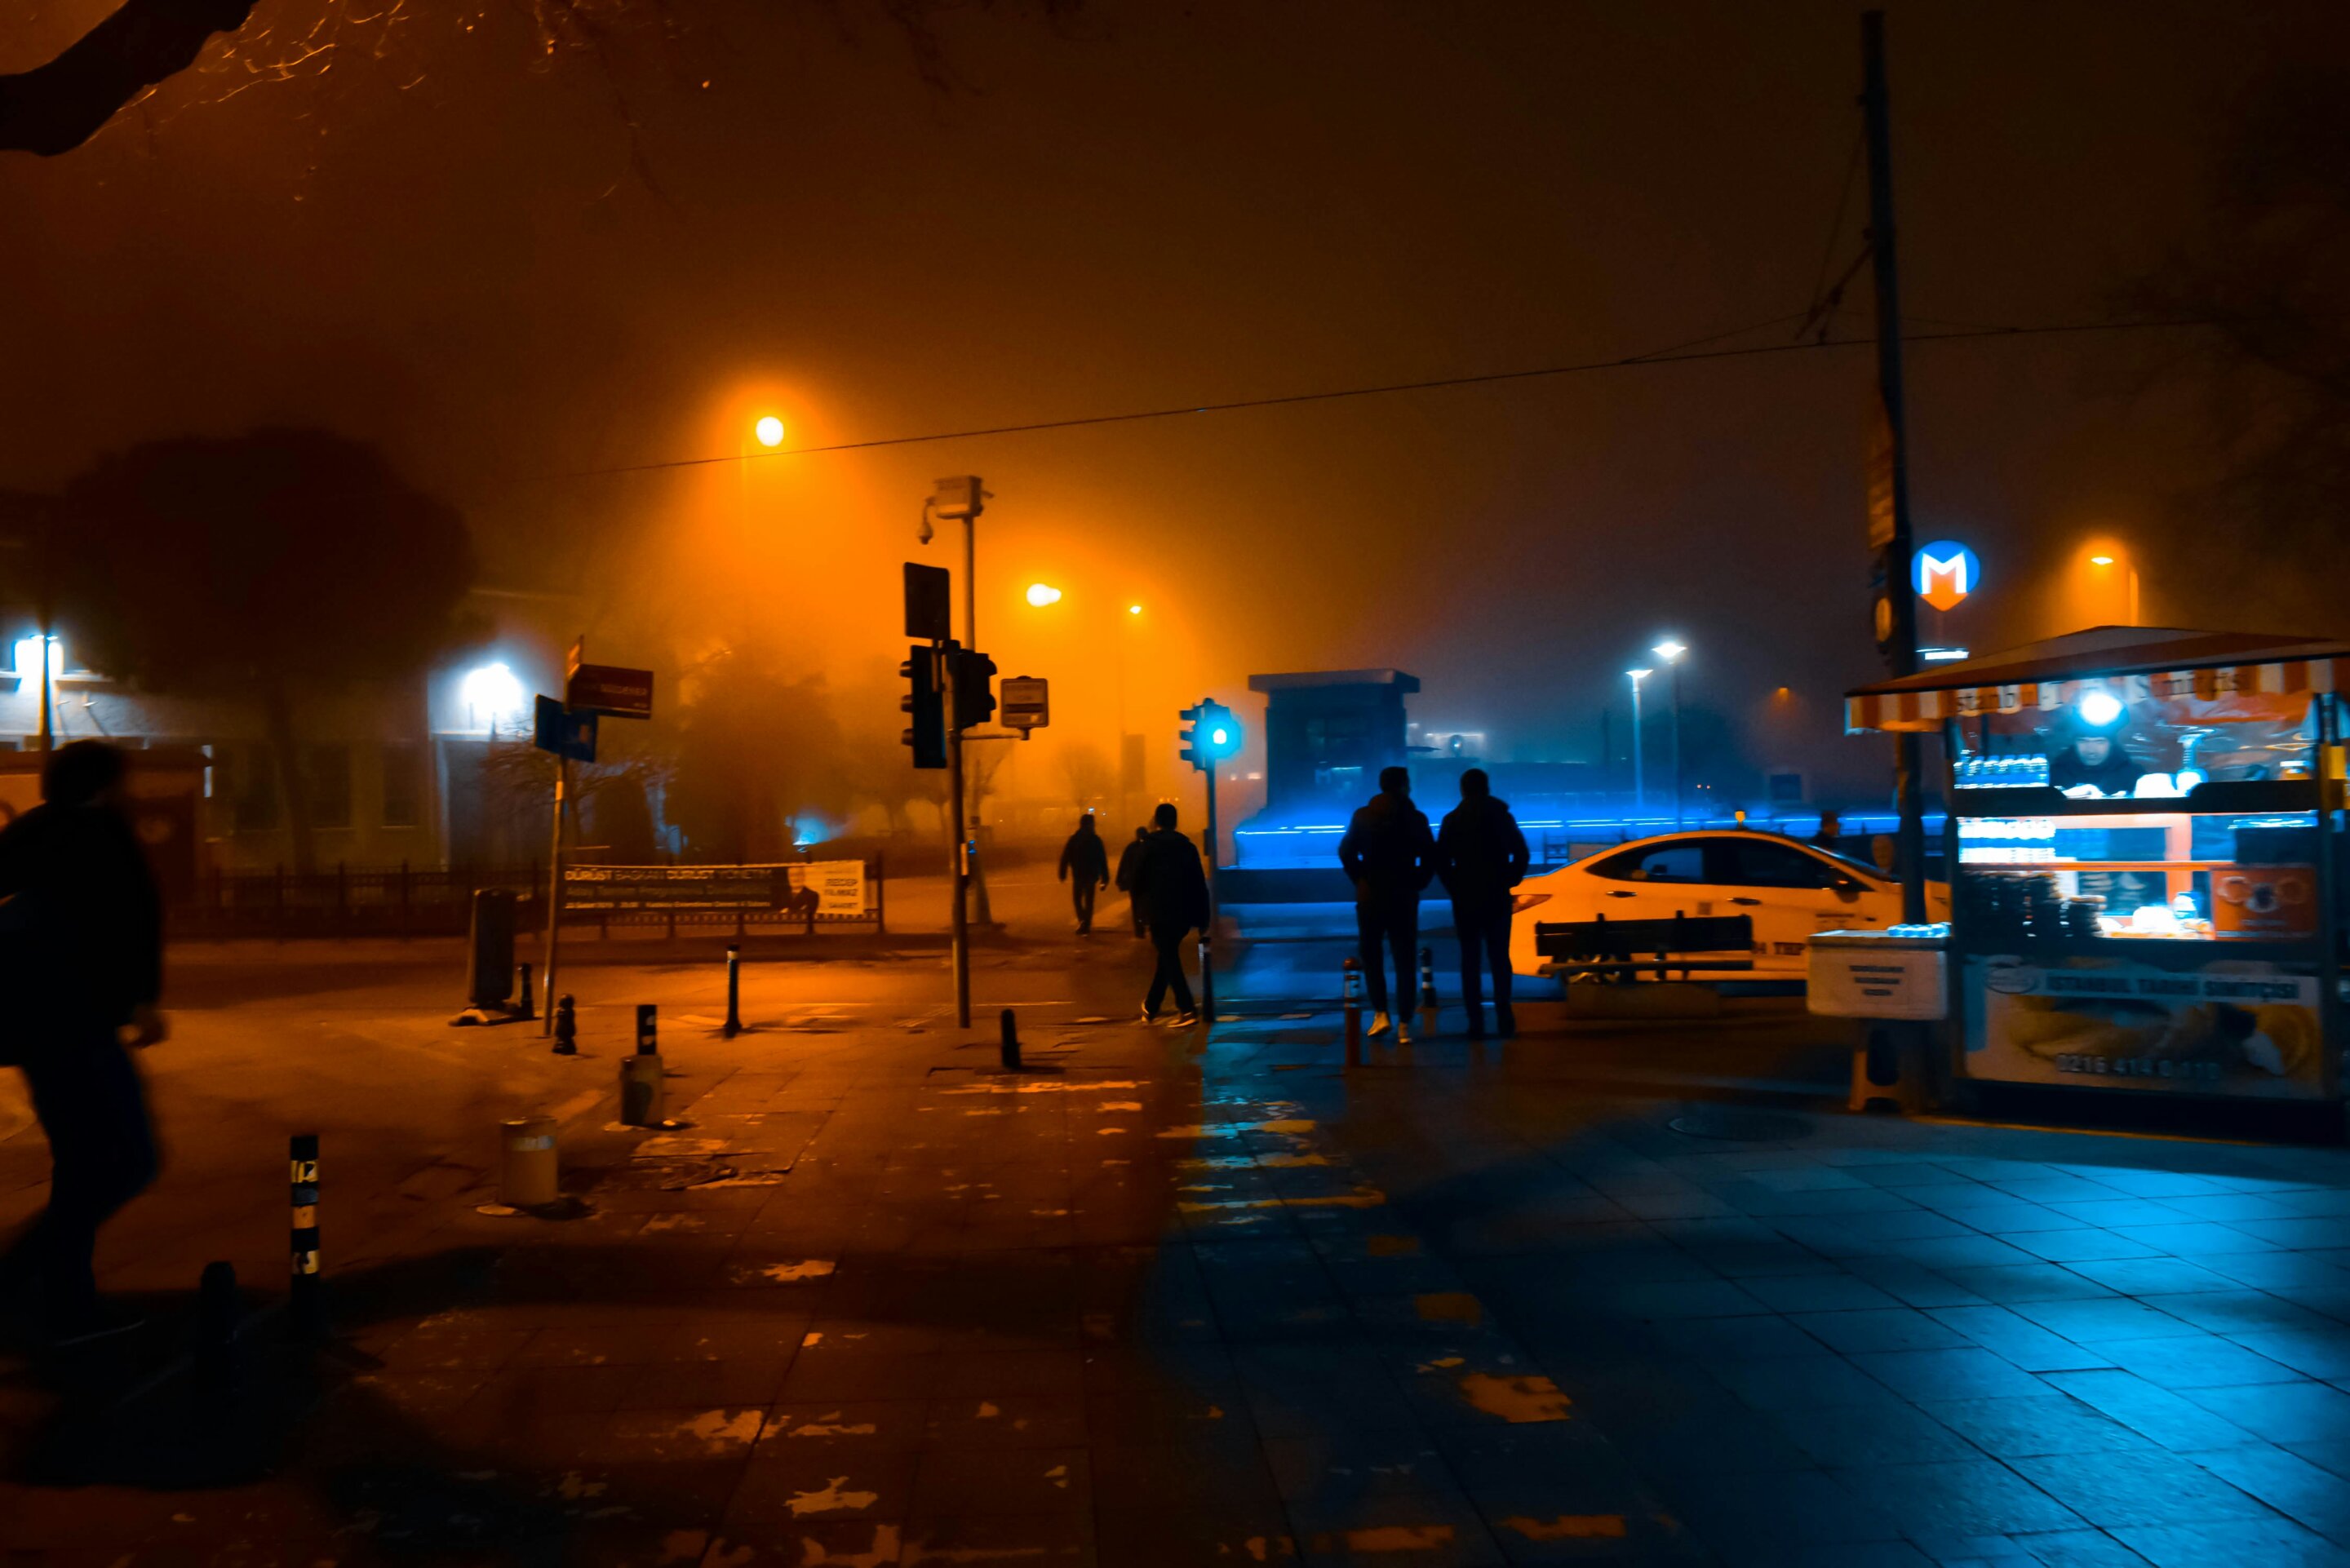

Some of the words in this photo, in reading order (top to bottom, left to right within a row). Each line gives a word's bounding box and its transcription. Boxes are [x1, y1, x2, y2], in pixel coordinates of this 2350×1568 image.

[1922, 551, 1966, 594] M
[565, 868, 612, 881] DÜRÜST
[2056, 1055, 2108, 1074] 0216
